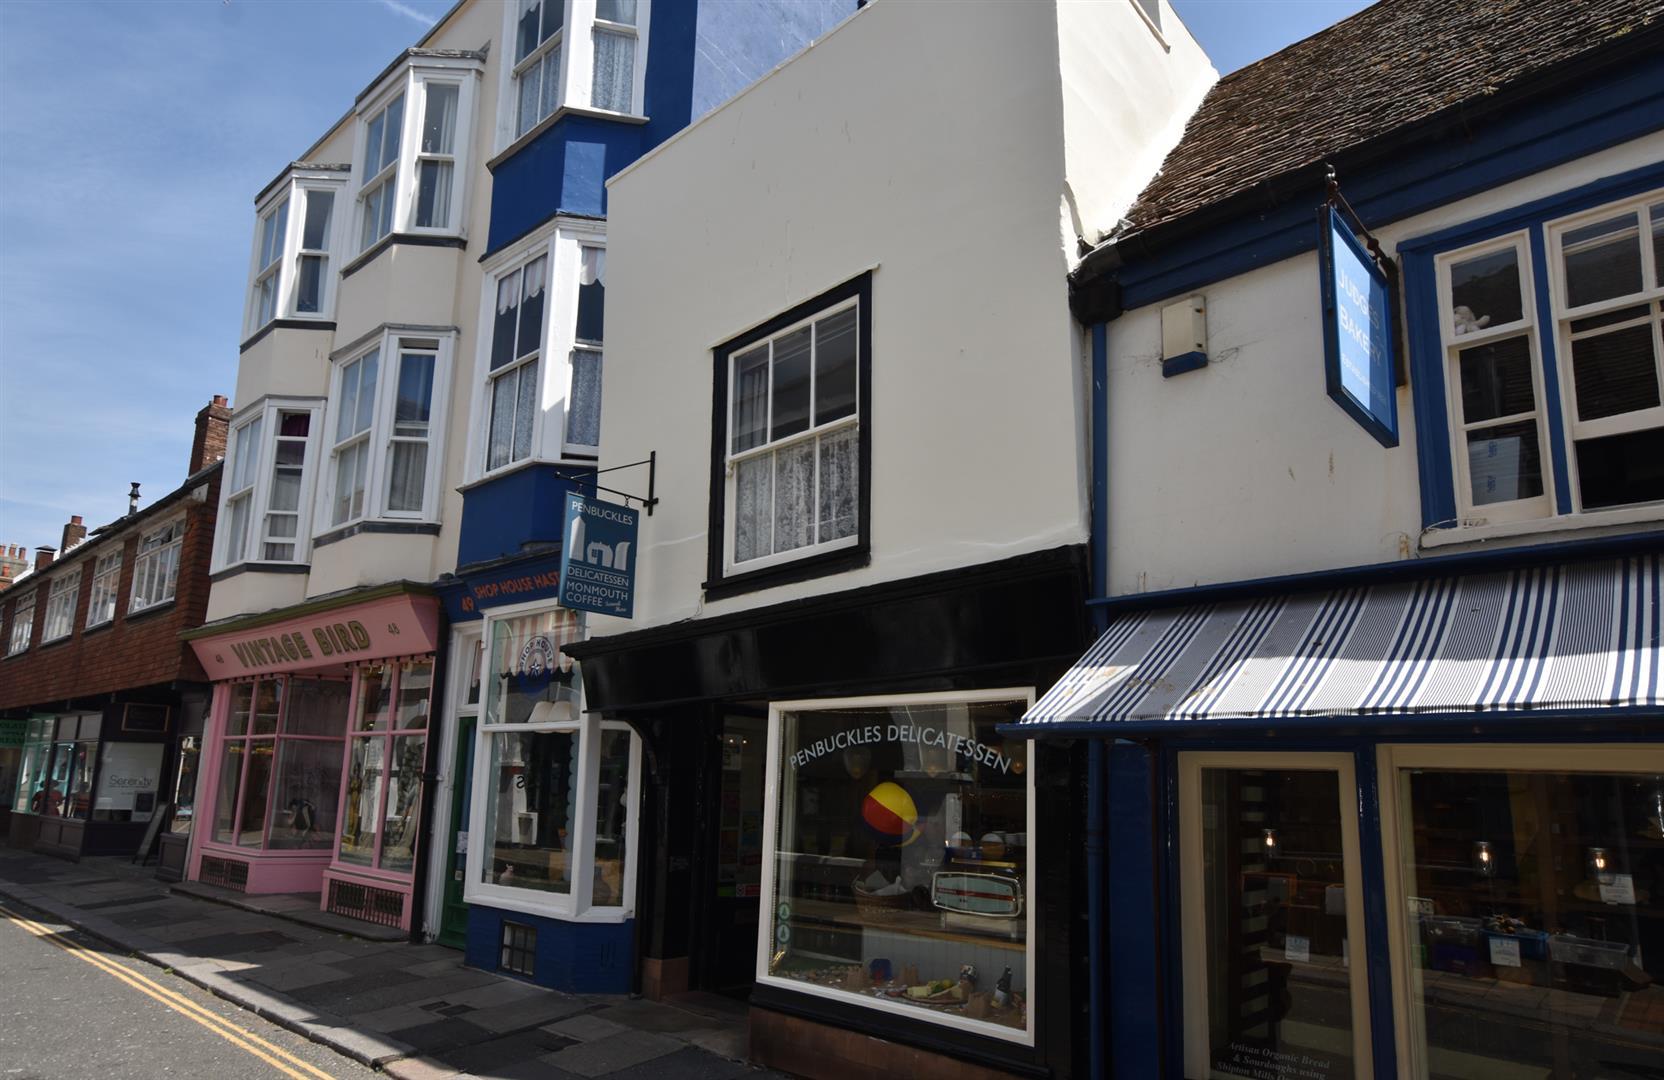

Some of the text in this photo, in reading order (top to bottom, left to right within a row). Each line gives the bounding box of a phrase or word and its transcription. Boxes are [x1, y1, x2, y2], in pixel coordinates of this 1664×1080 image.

[1339, 270, 1380, 330] JUDGES
[1340, 303, 1382, 367] BAKERY
[571, 500, 633, 526] PENBUCKLES
[474, 570, 561, 600] SHOP HOUSE HAST
[567, 566, 630, 587] DELICATESSEN
[461, 595, 475, 613] 49
[565, 591, 603, 607] COFFEE
[566, 580, 629, 601] MONMOUTH
[231, 620, 371, 668] VINTAGE BIRD
[789, 725, 882, 770] PENBUCKLES
[887, 725, 1011, 775] DELICATESSEN
[1227, 1041, 1330, 1069] Artisan Organic Bread
[1232, 1053, 1241, 1062] &
[1243, 1055, 1297, 1074] Sourdoughs
[1299, 1068, 1327, 1080] using
[1216, 1061, 1250, 1076] Shipton
[1254, 1069, 1275, 1080] Mills
